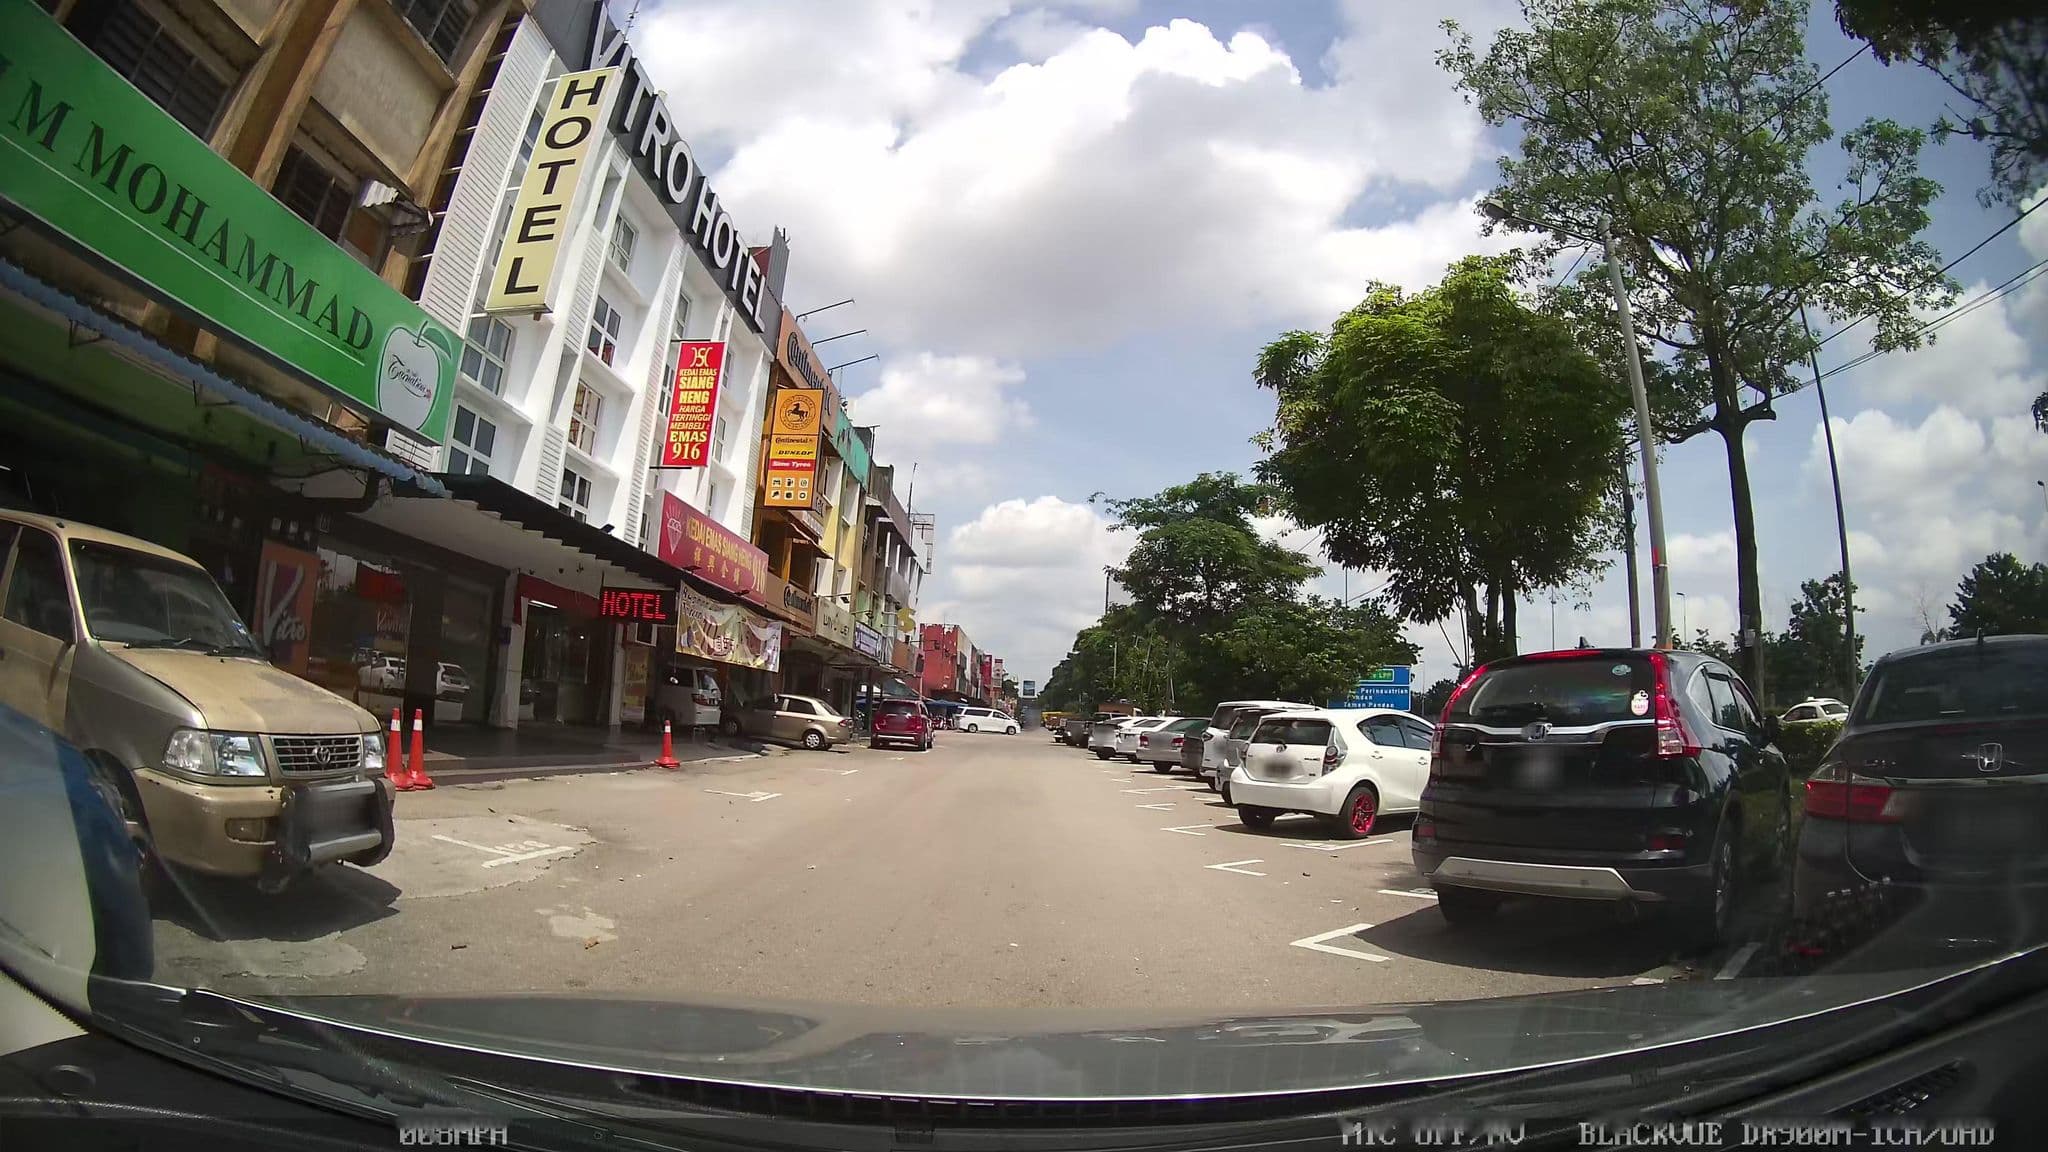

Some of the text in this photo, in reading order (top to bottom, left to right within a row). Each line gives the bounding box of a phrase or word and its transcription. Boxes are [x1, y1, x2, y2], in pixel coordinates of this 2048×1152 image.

[504, 75, 607, 295] HOTEL
[8, 79, 375, 352] M MOHAMMAD
[691, 176, 767, 333] HOTEL
[679, 368, 717, 376] KEDAI EMAS
[679, 376, 715, 389] SIANG
[679, 390, 710, 404] HENG
[679, 405, 706, 413] HARGA
[672, 413, 712, 421] TERTINGGI
[670, 422, 705, 430] MEMBELI
[670, 431, 707, 442] EMAS
[672, 442, 702, 460] 916
[601, 590, 667, 620] HOTEL
